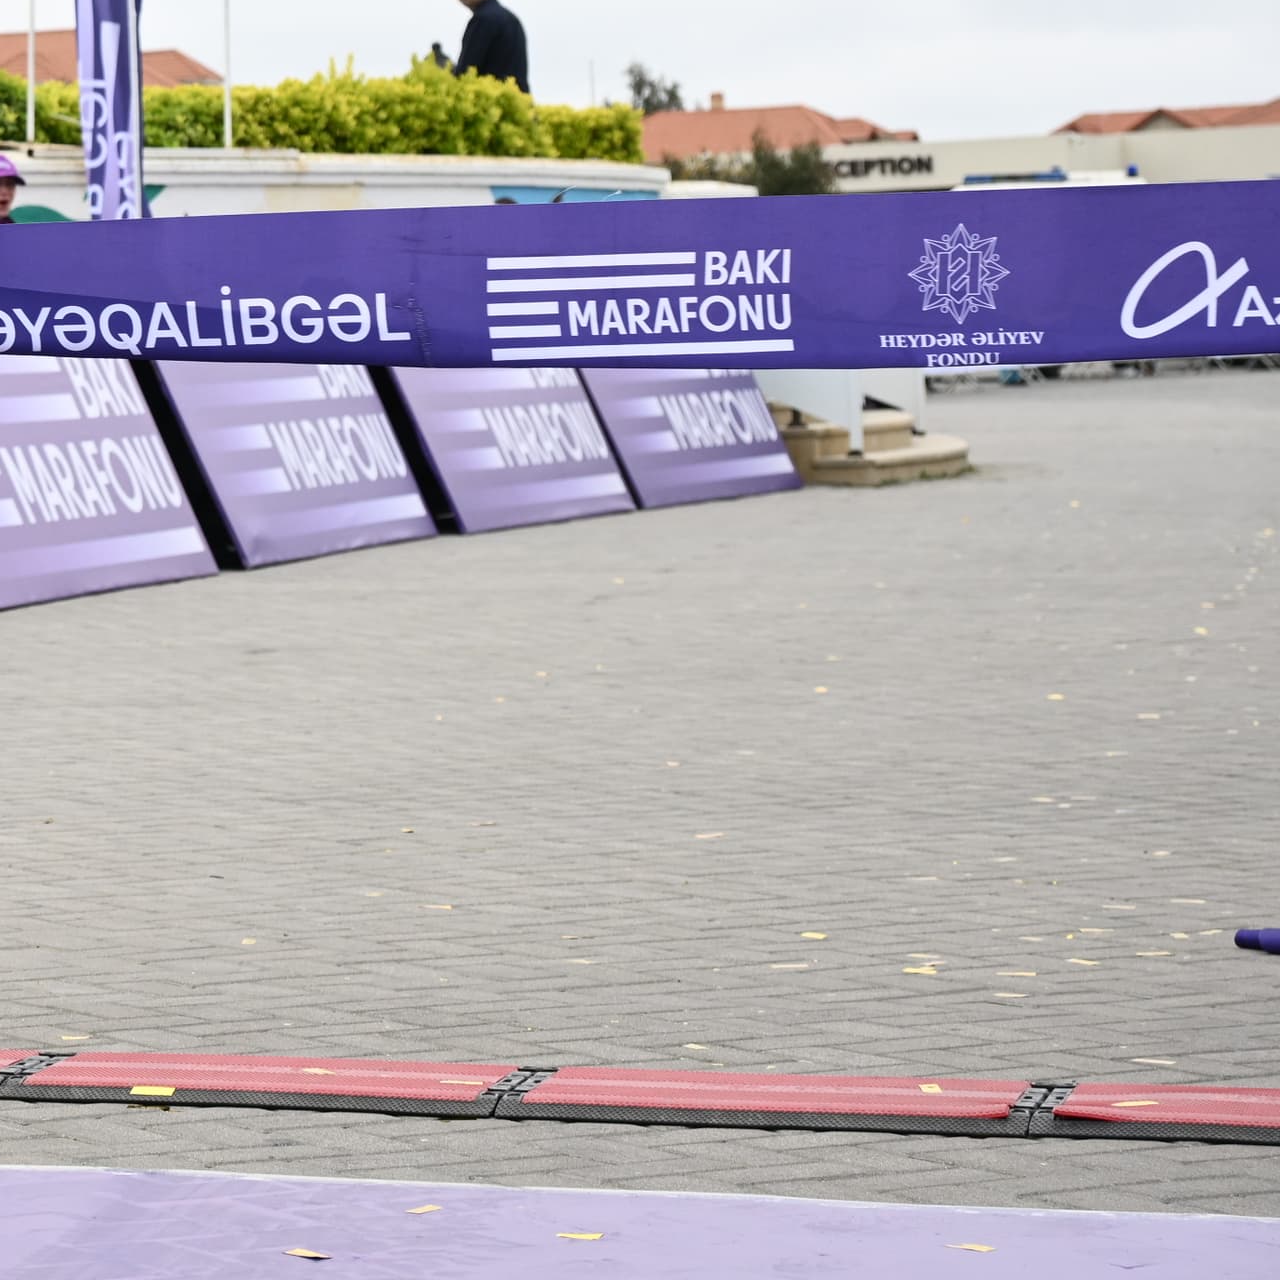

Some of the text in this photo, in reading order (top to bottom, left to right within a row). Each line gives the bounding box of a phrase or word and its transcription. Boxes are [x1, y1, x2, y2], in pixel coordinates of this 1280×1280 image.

[704, 248, 792, 286] BAKI
[567, 293, 793, 337] MARAFONU
[880, 327, 1045, 349] HEYDƏR ƏLİYEV
[926, 352, 1000, 368] FONDU
[482, 401, 610, 468] MARAFONU
[657, 388, 779, 451] MARAFONU
[268, 412, 408, 490] MARAFONU
